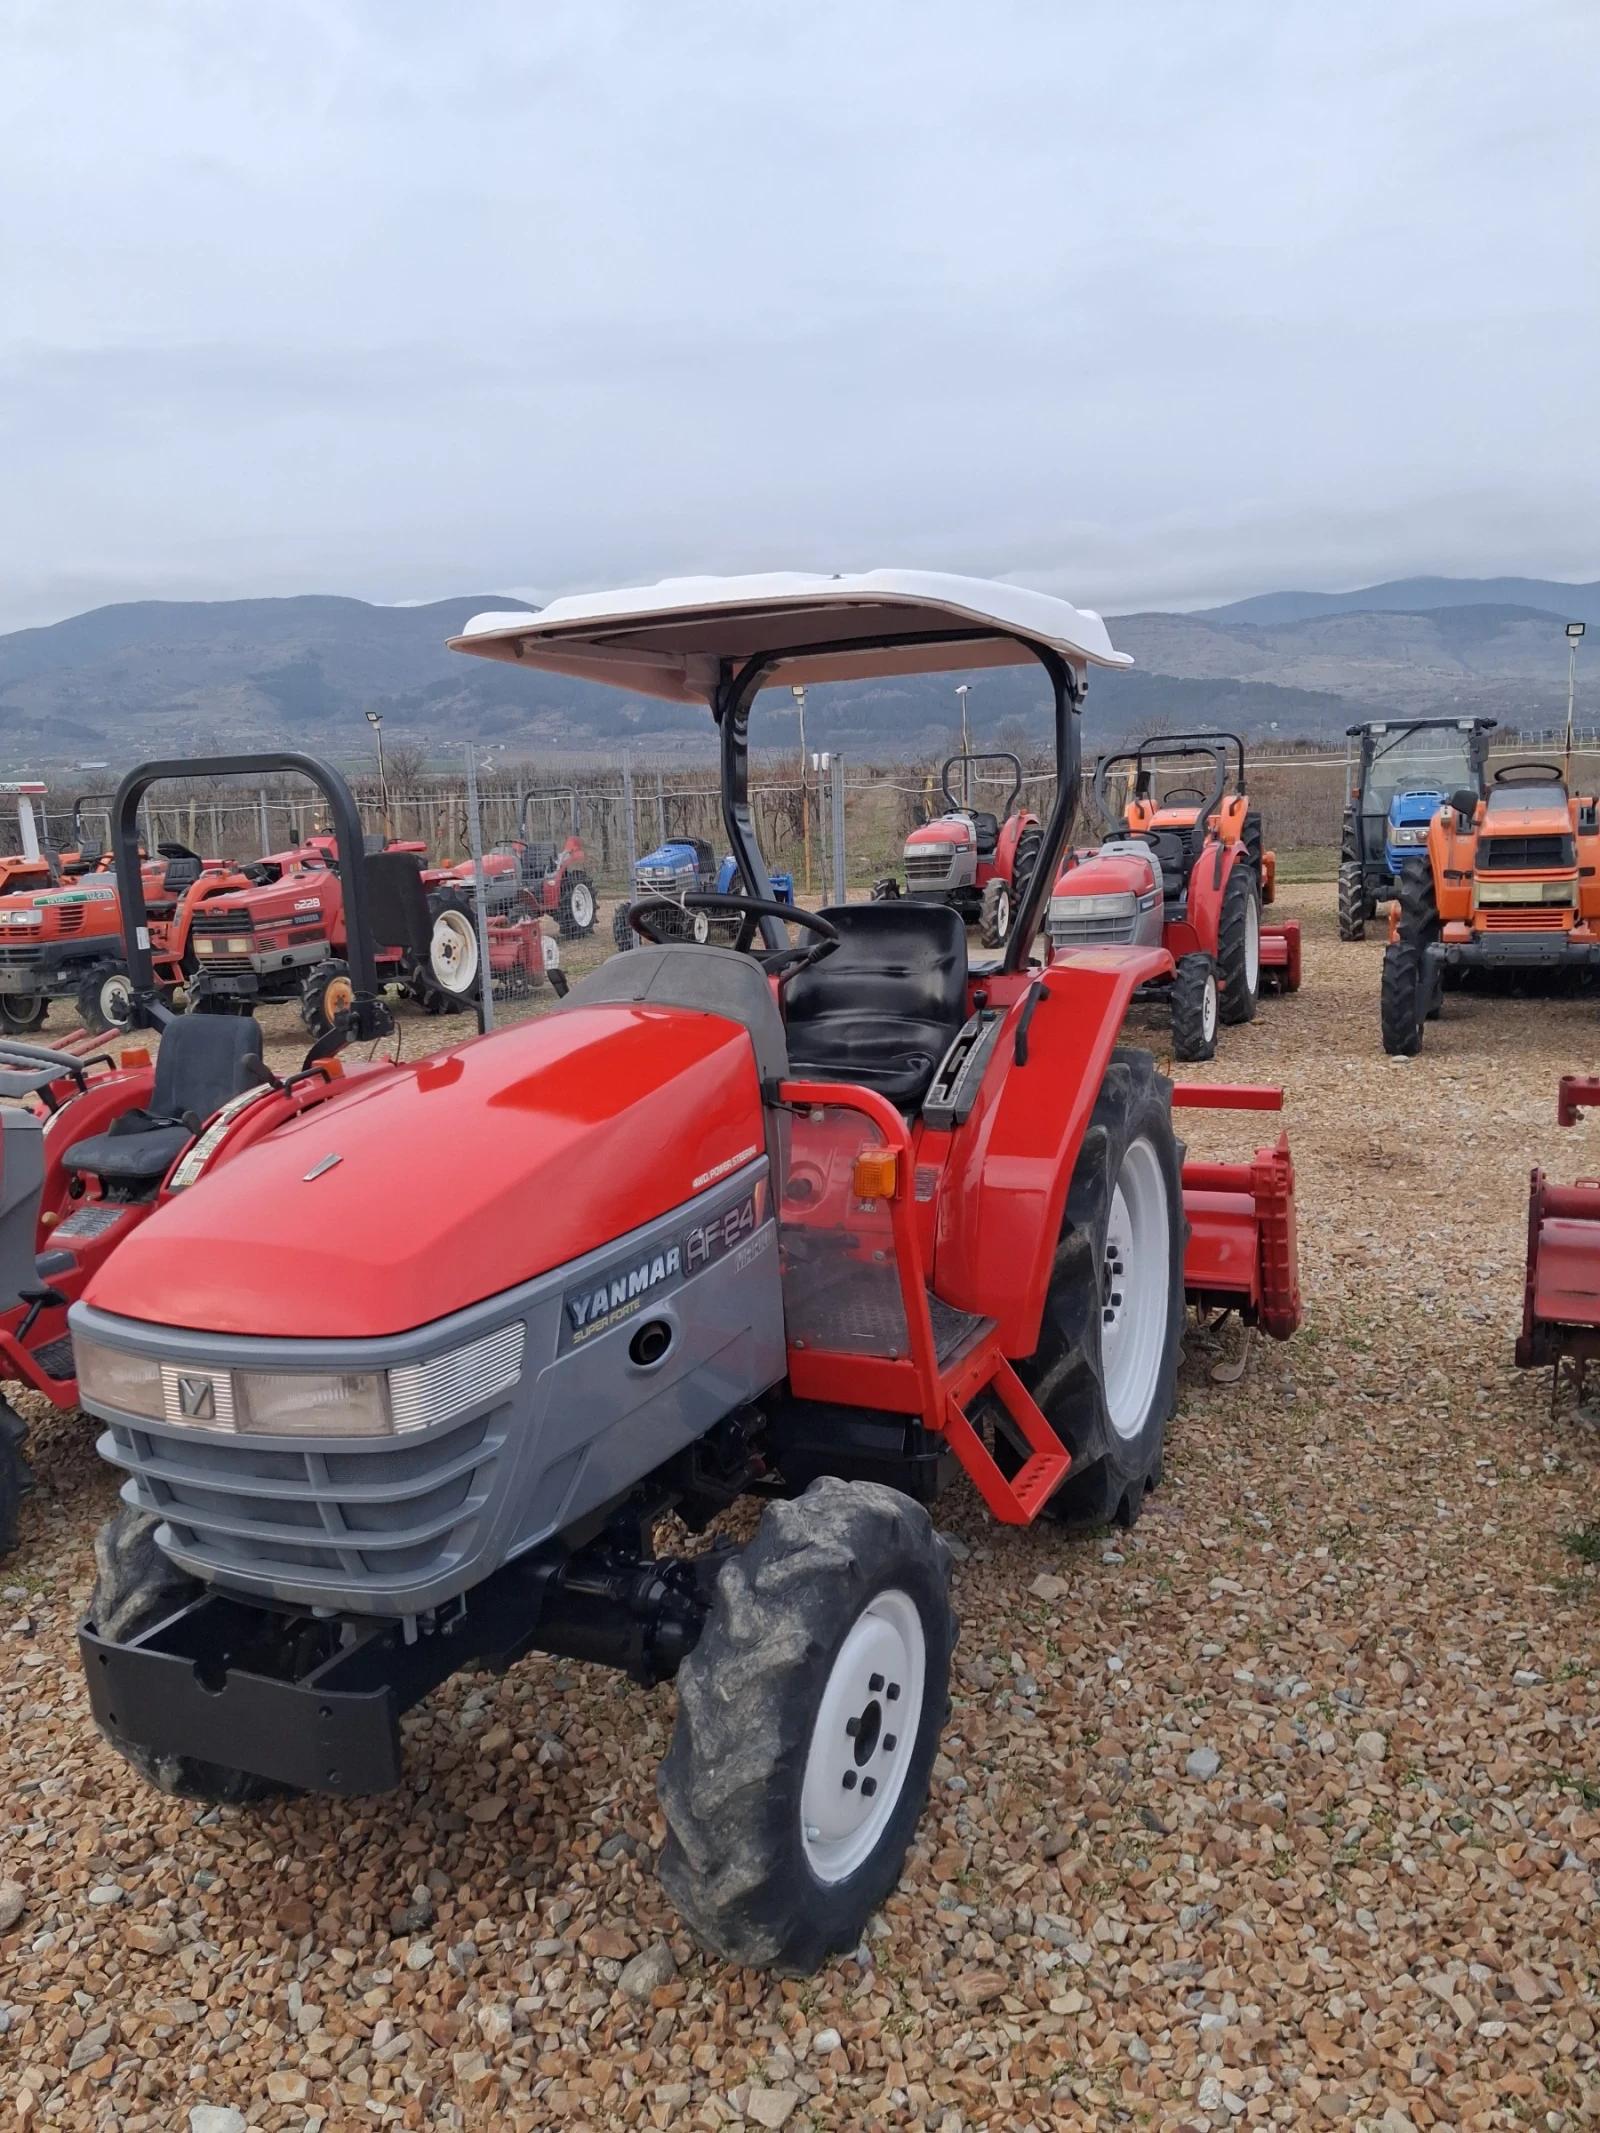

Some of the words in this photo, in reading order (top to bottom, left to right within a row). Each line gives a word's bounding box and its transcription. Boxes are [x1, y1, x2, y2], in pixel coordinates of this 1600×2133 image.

[710, 1158, 732, 1180] POWER
[571, 1246, 680, 1327] YANMAR
[573, 1316, 609, 1345] SUPER
[609, 1298, 641, 1323] FORTE
